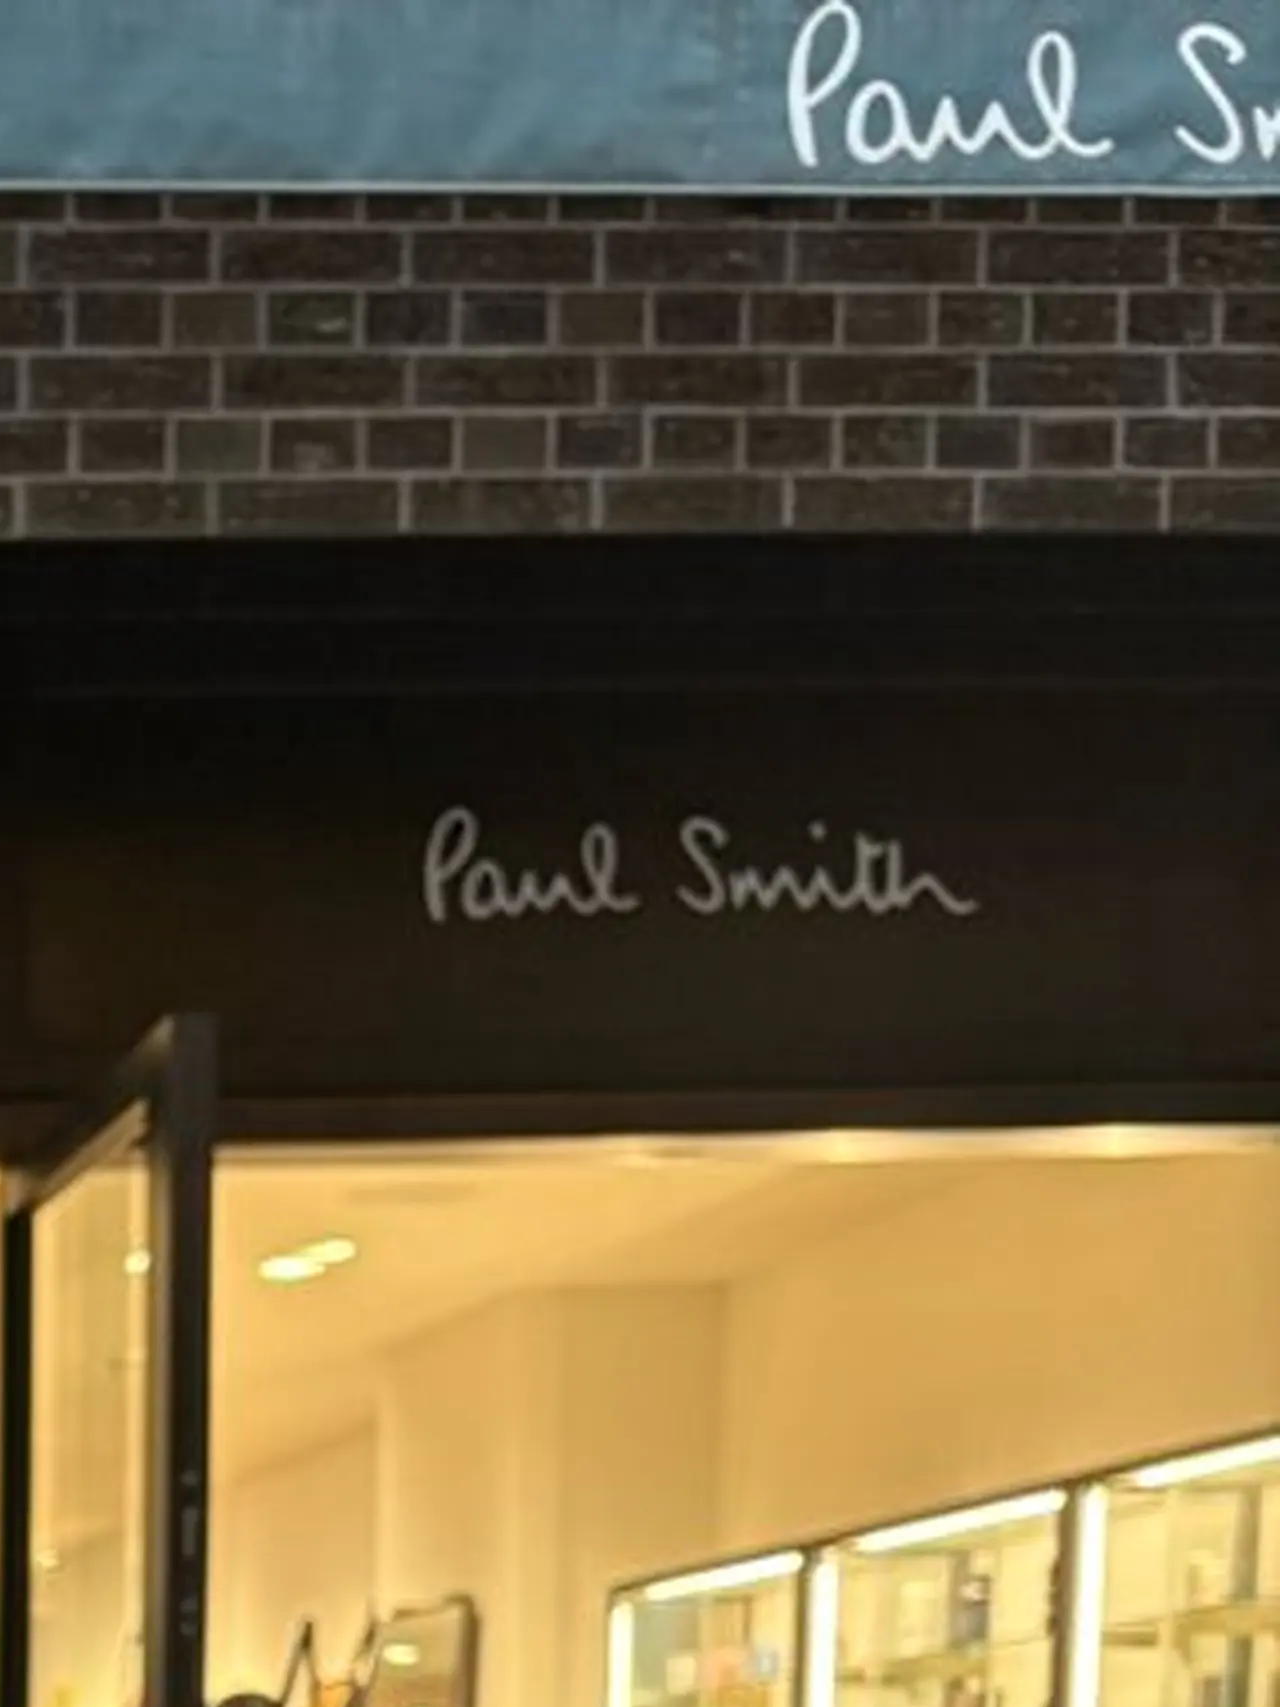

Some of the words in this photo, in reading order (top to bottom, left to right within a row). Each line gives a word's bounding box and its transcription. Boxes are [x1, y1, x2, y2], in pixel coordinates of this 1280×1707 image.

[787, 0, 1115, 168] Paul
[423, 806, 639, 922] Paul
[676, 816, 979, 915] Smith
